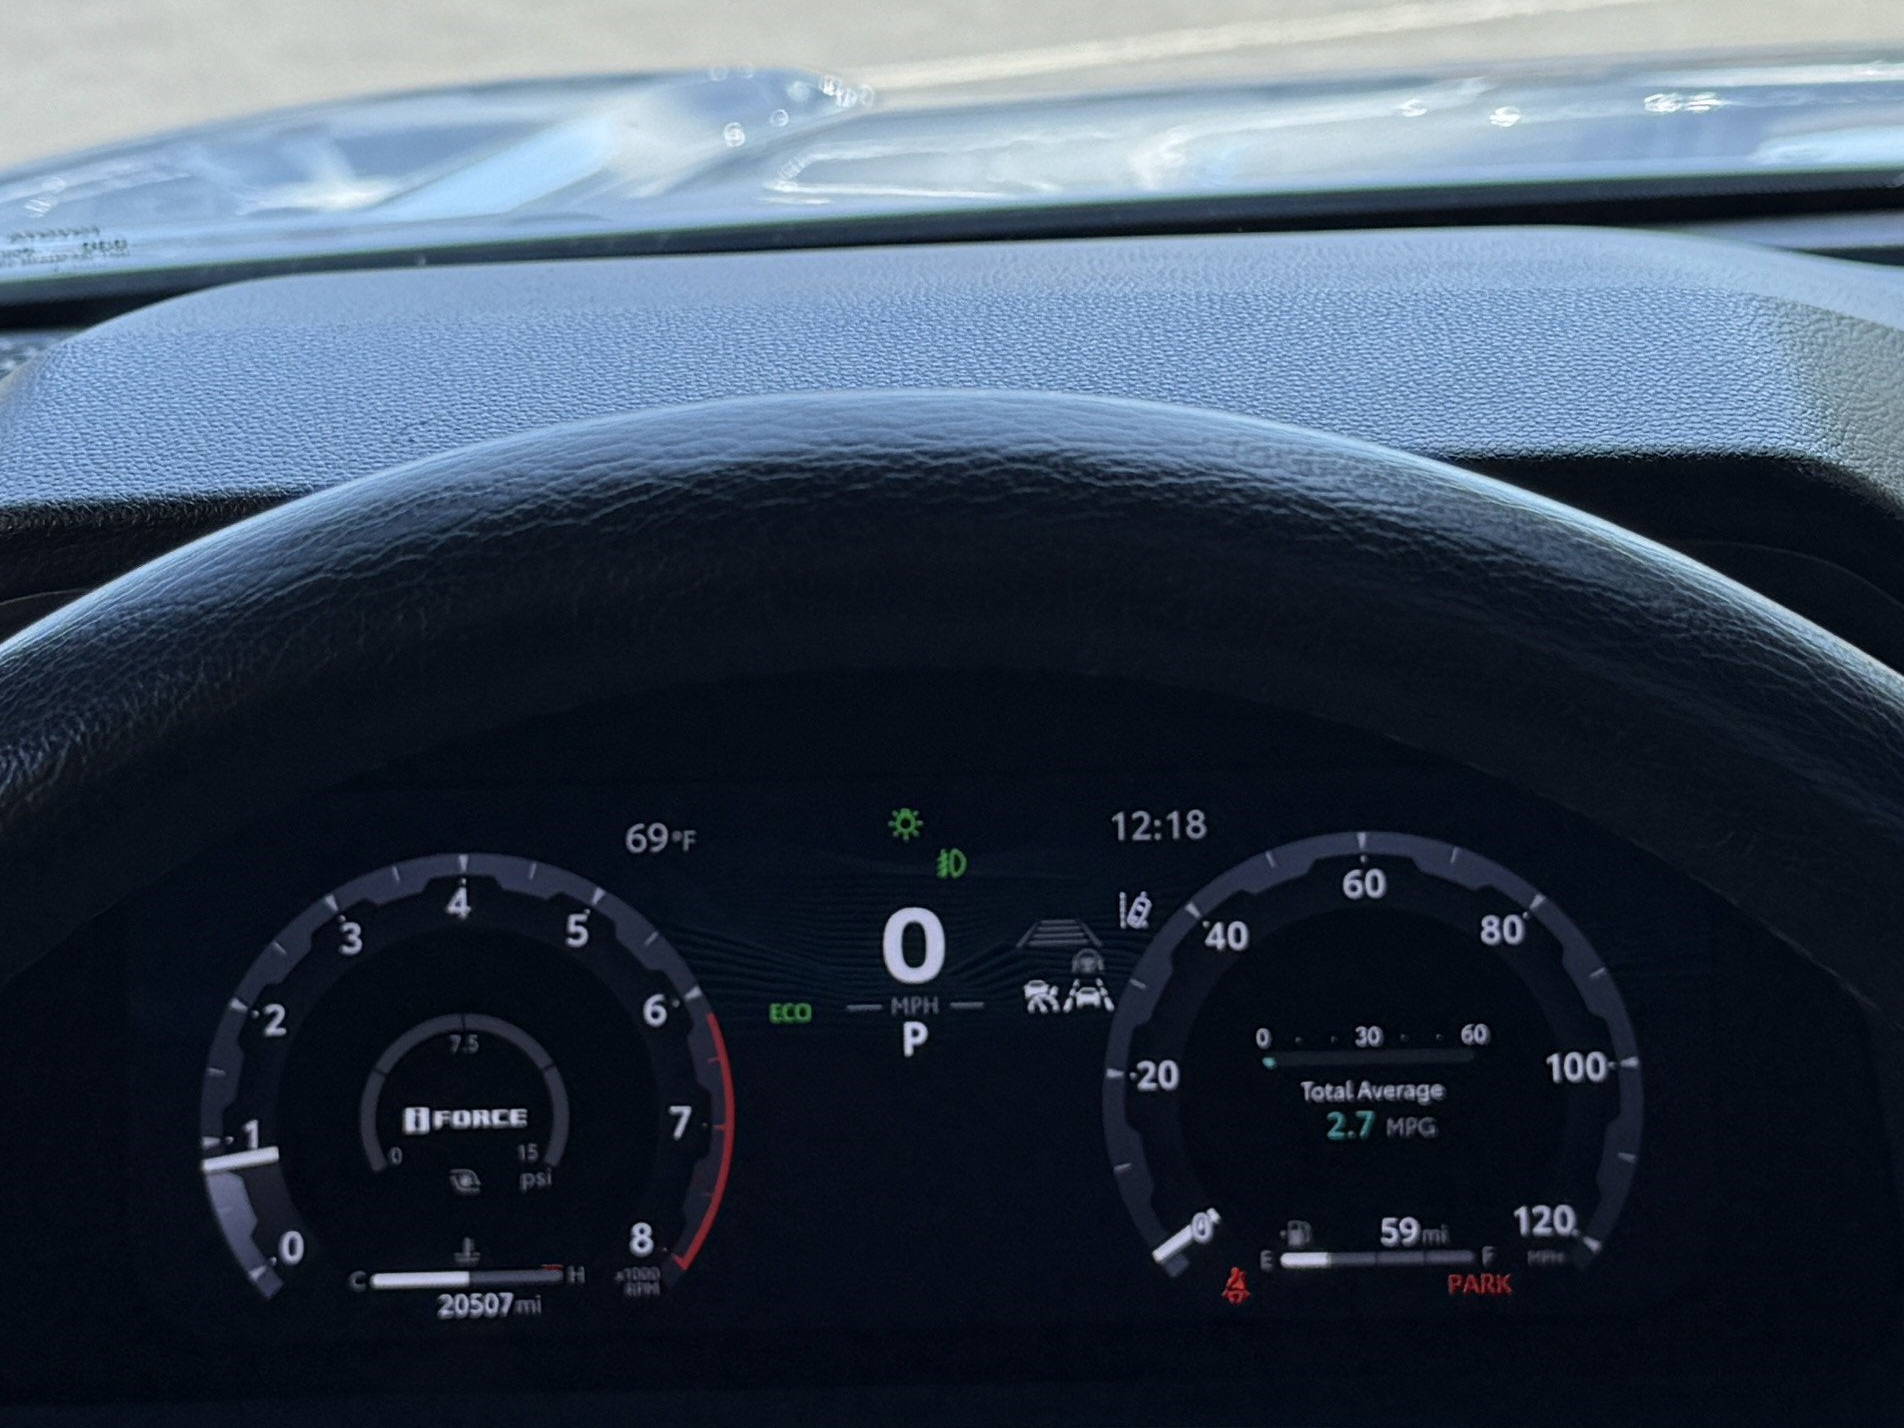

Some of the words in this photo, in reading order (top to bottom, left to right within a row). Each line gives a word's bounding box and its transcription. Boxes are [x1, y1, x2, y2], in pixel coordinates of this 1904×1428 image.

[1112, 810, 1206, 840] 12:18
[1343, 869, 1385, 898] 60
[448, 888, 470, 918] 4
[342, 922, 362, 954] 3
[568, 914, 588, 946] 5
[1203, 921, 1248, 950] 40
[1481, 915, 1523, 944] 80
[883, 908, 944, 983] 0
[266, 1004, 286, 1035] 2
[644, 994, 666, 1026] 6
[770, 1003, 811, 1022] ECO
[891, 997, 938, 1014] MPH
[450, 1035, 479, 1052] 7.5
[904, 1022, 927, 1056] P
[1256, 1028, 1271, 1048] 0
[1356, 1026, 1382, 1046] 30
[1461, 1024, 1488, 1044] 60
[1138, 1061, 1178, 1089] 20
[1547, 1052, 1606, 1081] 100
[1301, 1081, 1353, 1101] Total
[1358, 1081, 1444, 1105] Average
[243, 1120, 261, 1147] 1
[670, 1106, 691, 1138] 7
[1328, 1111, 1374, 1139] 2.7
[1387, 1117, 1435, 1136] MPG
[390, 1147, 402, 1164] 0
[519, 1143, 538, 1161] 15
[520, 1168, 551, 1190] psi
[1515, 1205, 1577, 1235] 120
[281, 1231, 303, 1263] 0
[631, 1223, 653, 1254] 8
[1261, 1250, 1272, 1270] E
[1528, 1250, 1564, 1263] MPH
[1448, 1274, 1511, 1293] PARK
